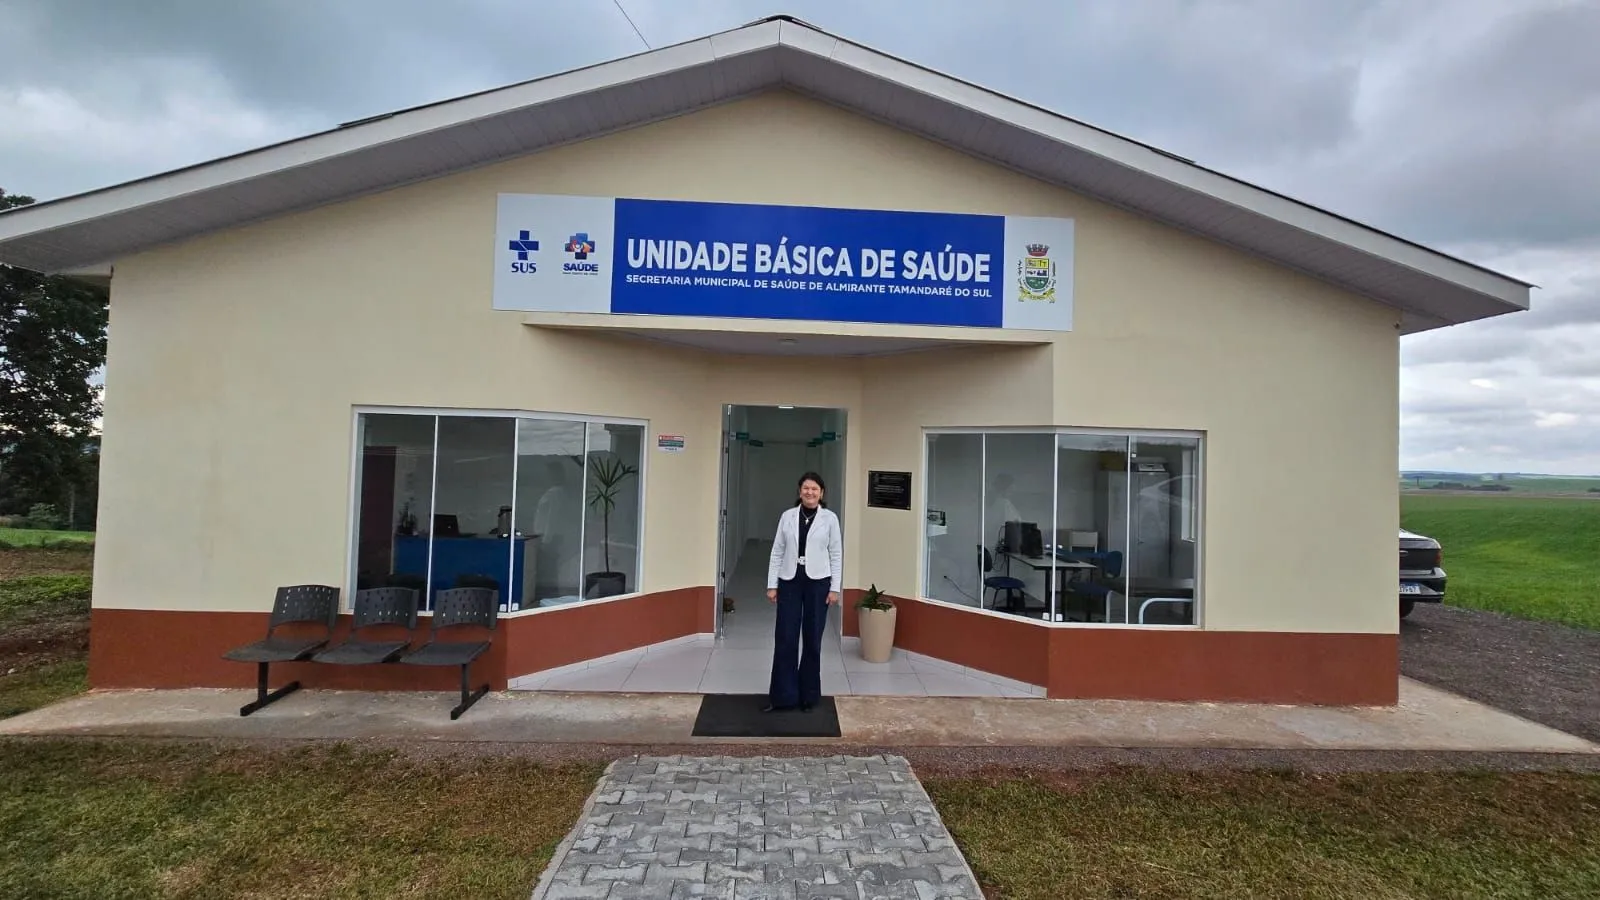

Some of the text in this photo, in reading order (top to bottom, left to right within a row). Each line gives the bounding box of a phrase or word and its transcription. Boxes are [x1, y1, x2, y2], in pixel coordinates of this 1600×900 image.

[511, 262, 537, 274] SUS
[563, 261, 599, 273] SAÚDE
[626, 235, 990, 283] UNIDADE BÁSICA DE SAÚDE
[625, 274, 992, 298] SECRETARIA MUNICIPAL DE SAÚDE DE ALMIRANTE TAMANDARÉ DO SUL
